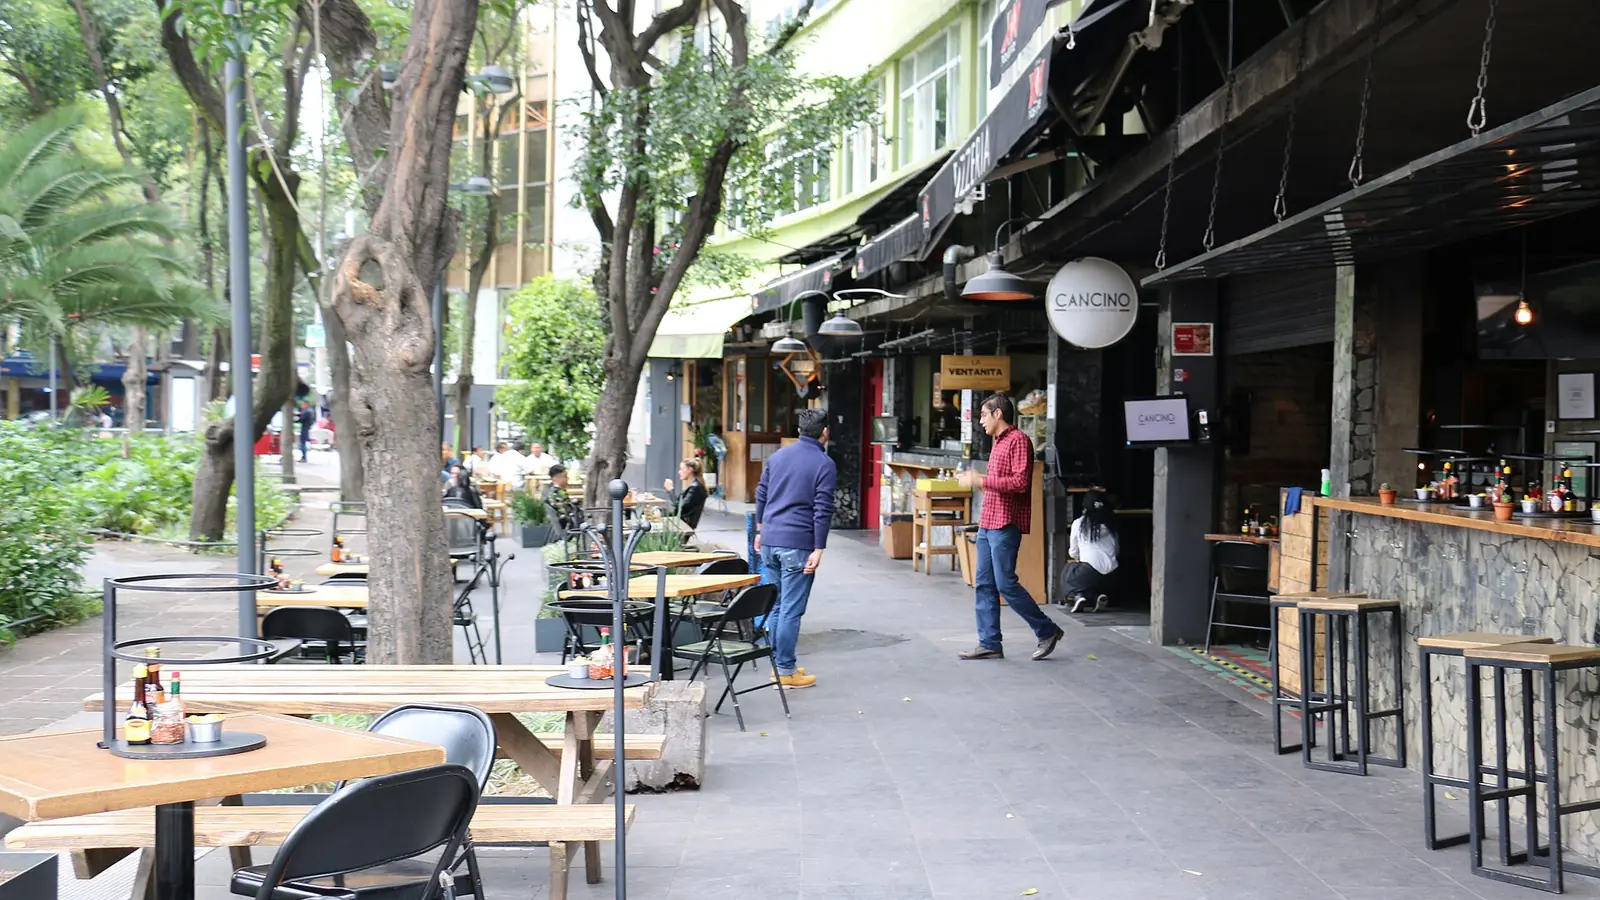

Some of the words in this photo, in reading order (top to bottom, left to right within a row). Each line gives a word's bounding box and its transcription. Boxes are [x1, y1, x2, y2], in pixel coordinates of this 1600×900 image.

[1055, 293, 1130, 307] CANCINO
[948, 368, 1003, 376] VENTANITA
[1138, 413, 1175, 423] CANCINO
